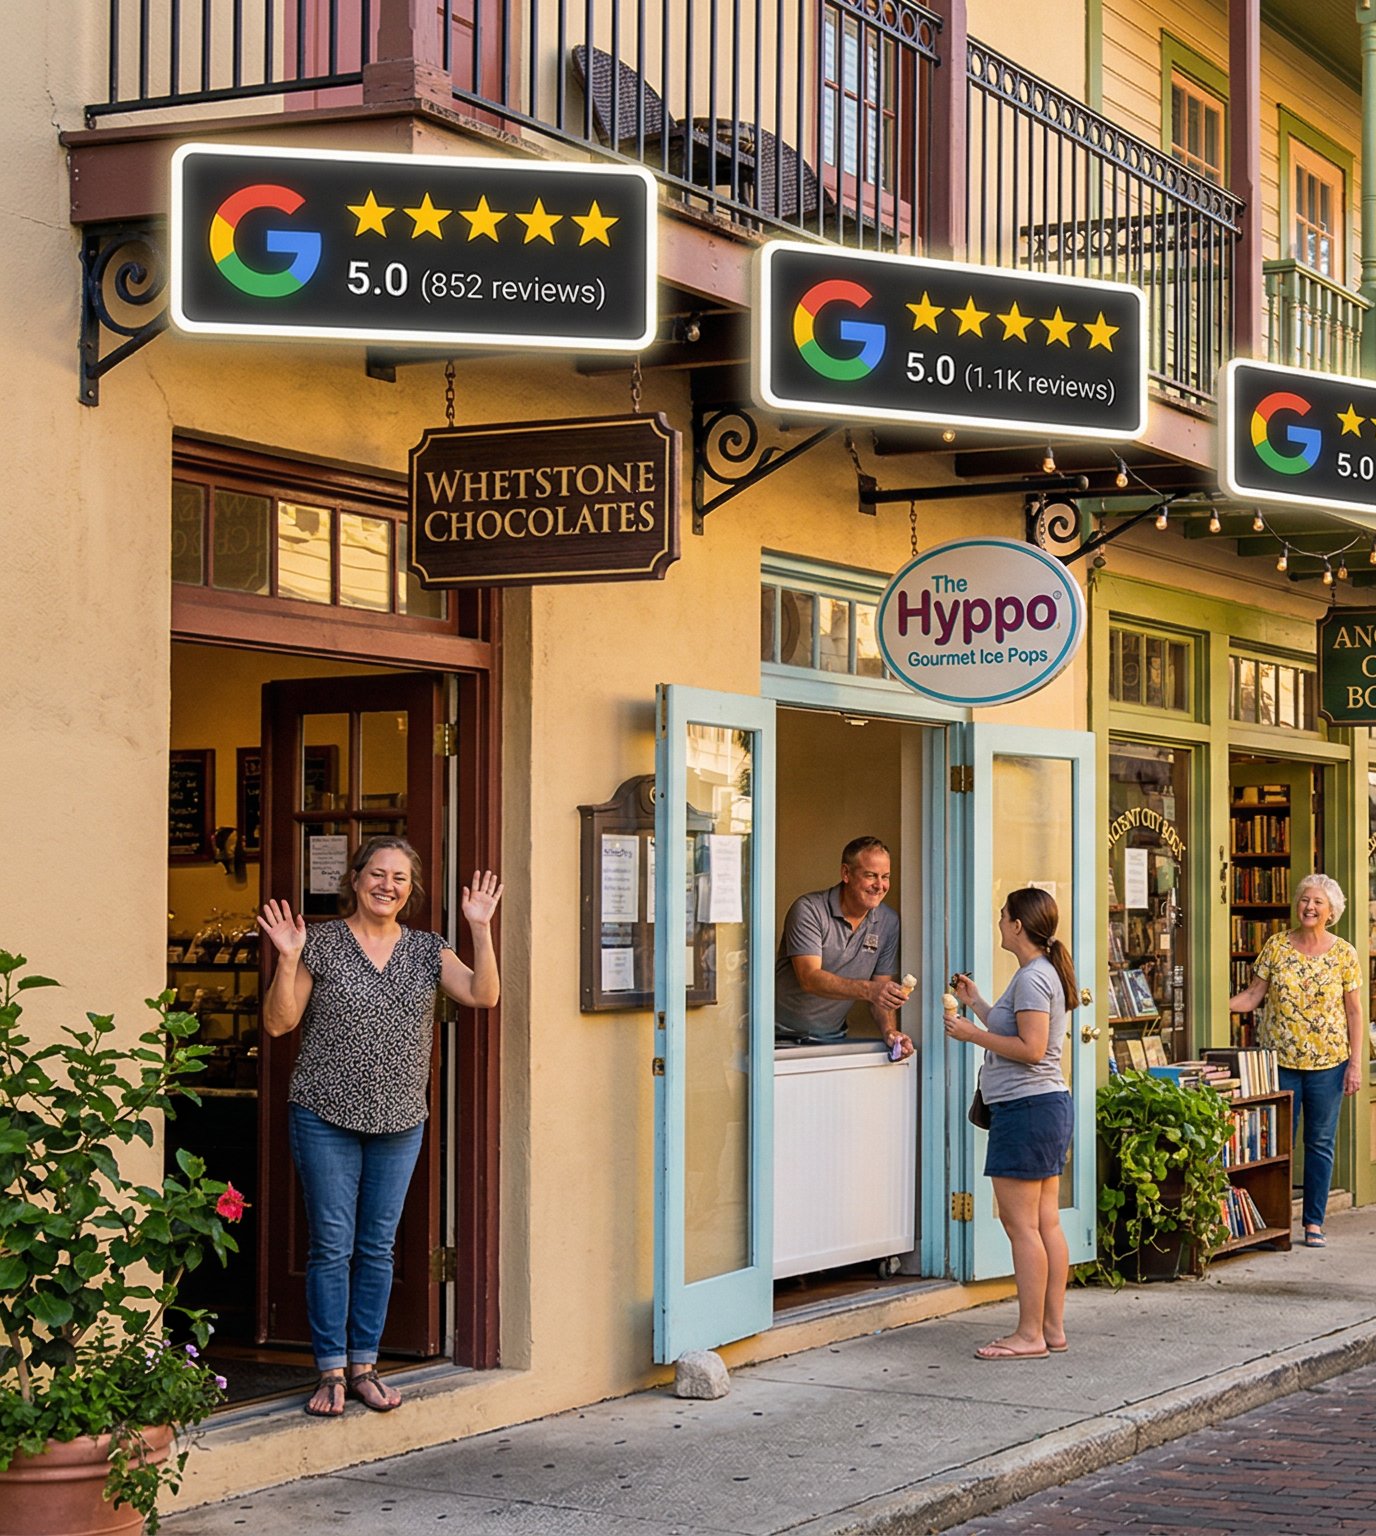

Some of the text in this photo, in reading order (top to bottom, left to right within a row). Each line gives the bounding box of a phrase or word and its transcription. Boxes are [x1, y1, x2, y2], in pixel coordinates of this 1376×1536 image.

[347, 260, 606, 309] 5.0 (852 reviews)
[906, 352, 1115, 406] 5.0 (1.1K reviews)
[424, 461, 656, 504] WHETSTONE
[1337, 452, 1374, 480] 5.0
[424, 500, 655, 542] CHOCOLATES
[931, 575, 968, 593] The
[908, 647, 1048, 667] Gourmet Ice Pops
